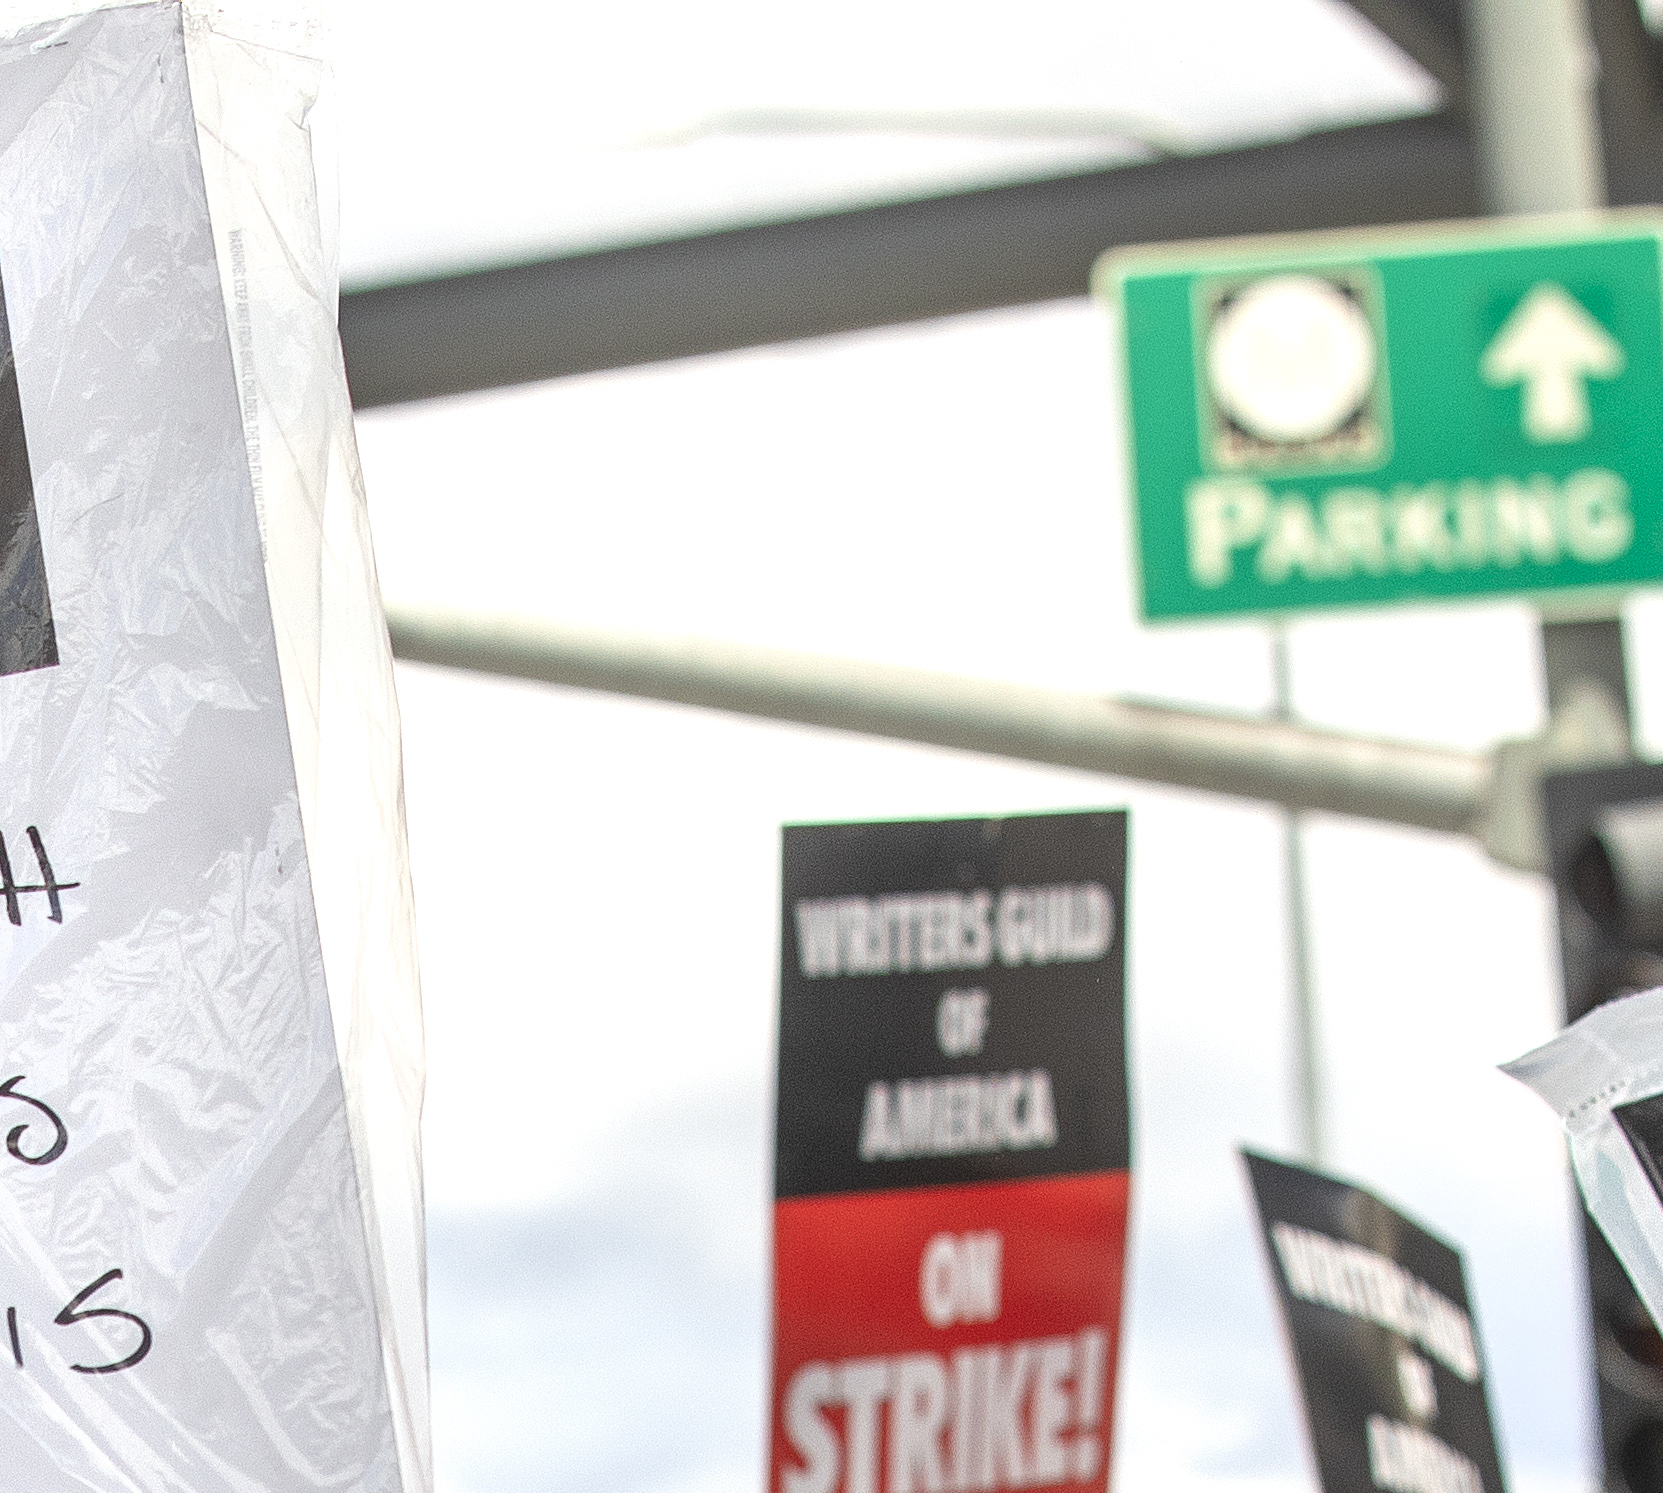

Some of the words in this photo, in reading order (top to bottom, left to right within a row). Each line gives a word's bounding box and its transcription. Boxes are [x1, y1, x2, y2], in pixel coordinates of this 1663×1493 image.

[794, 890, 992, 979] WRITERS
[997, 880, 1115, 968] GUILD
[858, 1066, 1060, 1163] AMERICA
[4, 1268, 155, 1376] IS
[920, 1230, 1002, 1327] ON
